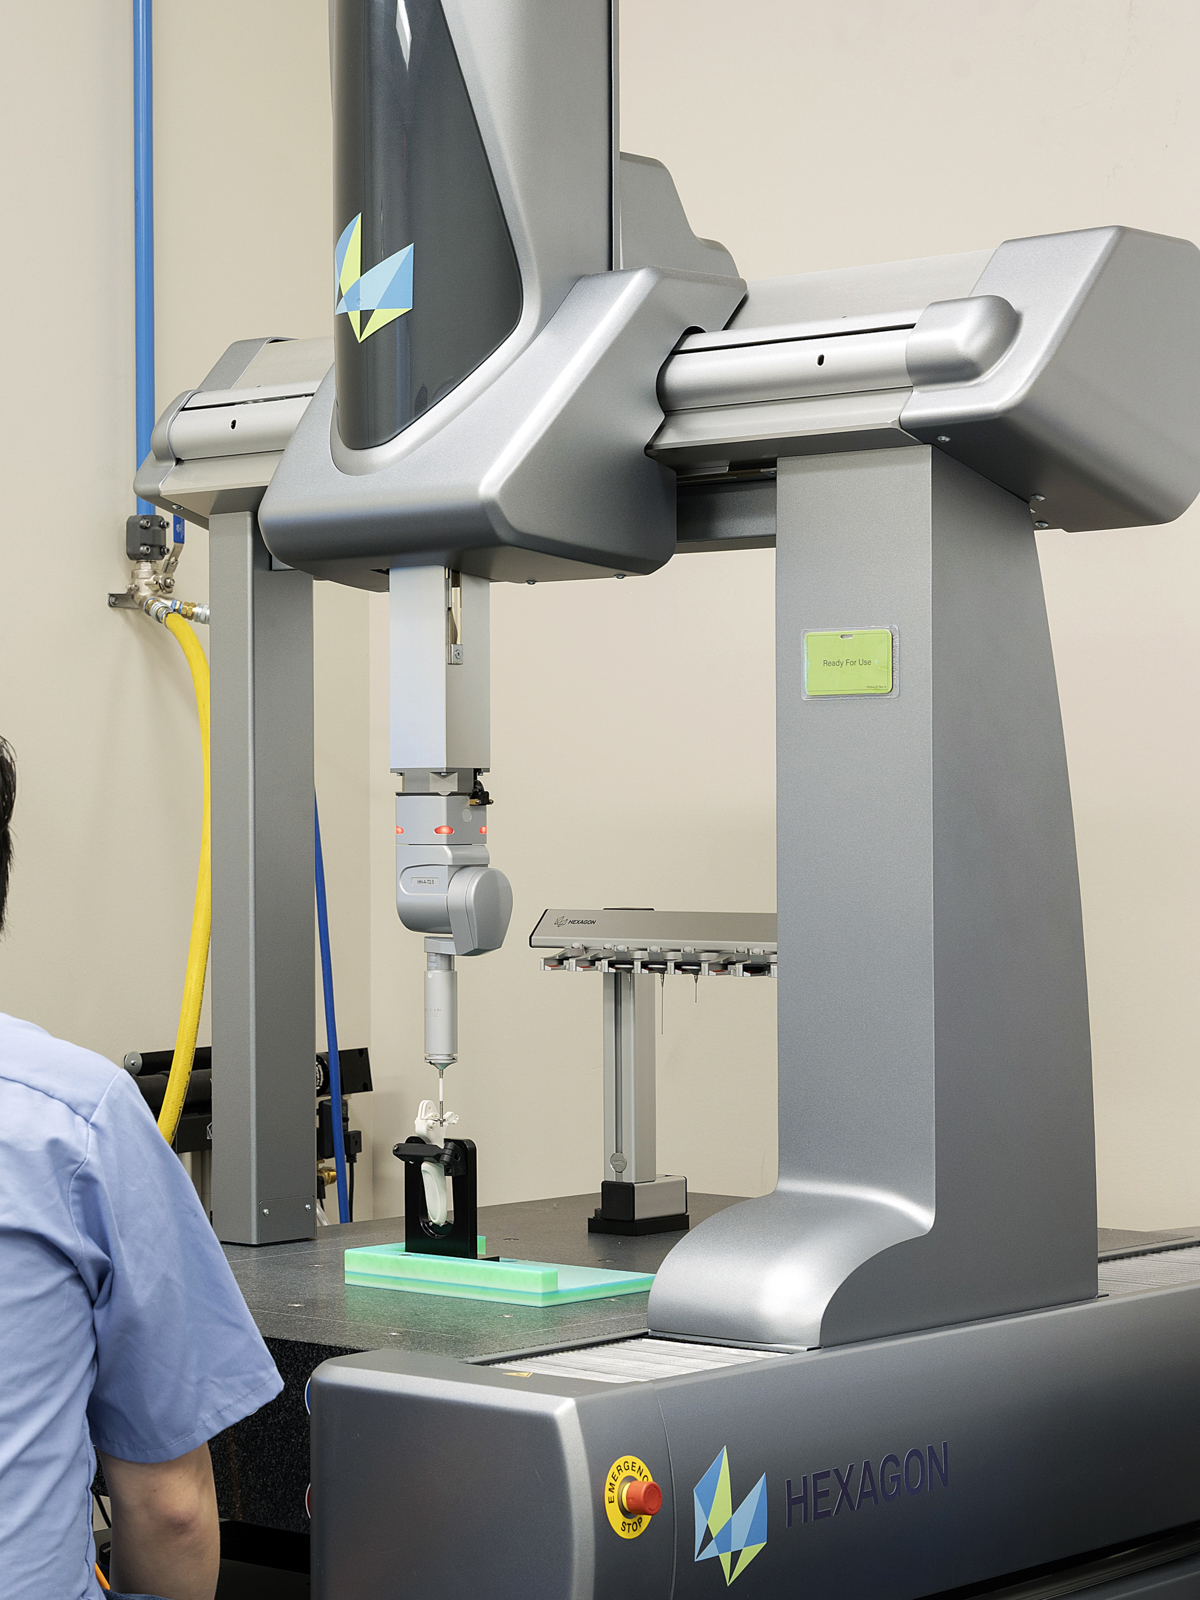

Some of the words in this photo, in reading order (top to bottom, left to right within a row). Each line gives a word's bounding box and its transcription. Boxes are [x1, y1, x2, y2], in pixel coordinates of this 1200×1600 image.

[823, 659, 844, 668] Ready
[858, 658, 871, 666] Use
[608, 1461, 649, 1504] EMERGENC
[785, 1441, 949, 1528] HEXAGON
[621, 1517, 642, 1533] STOP
